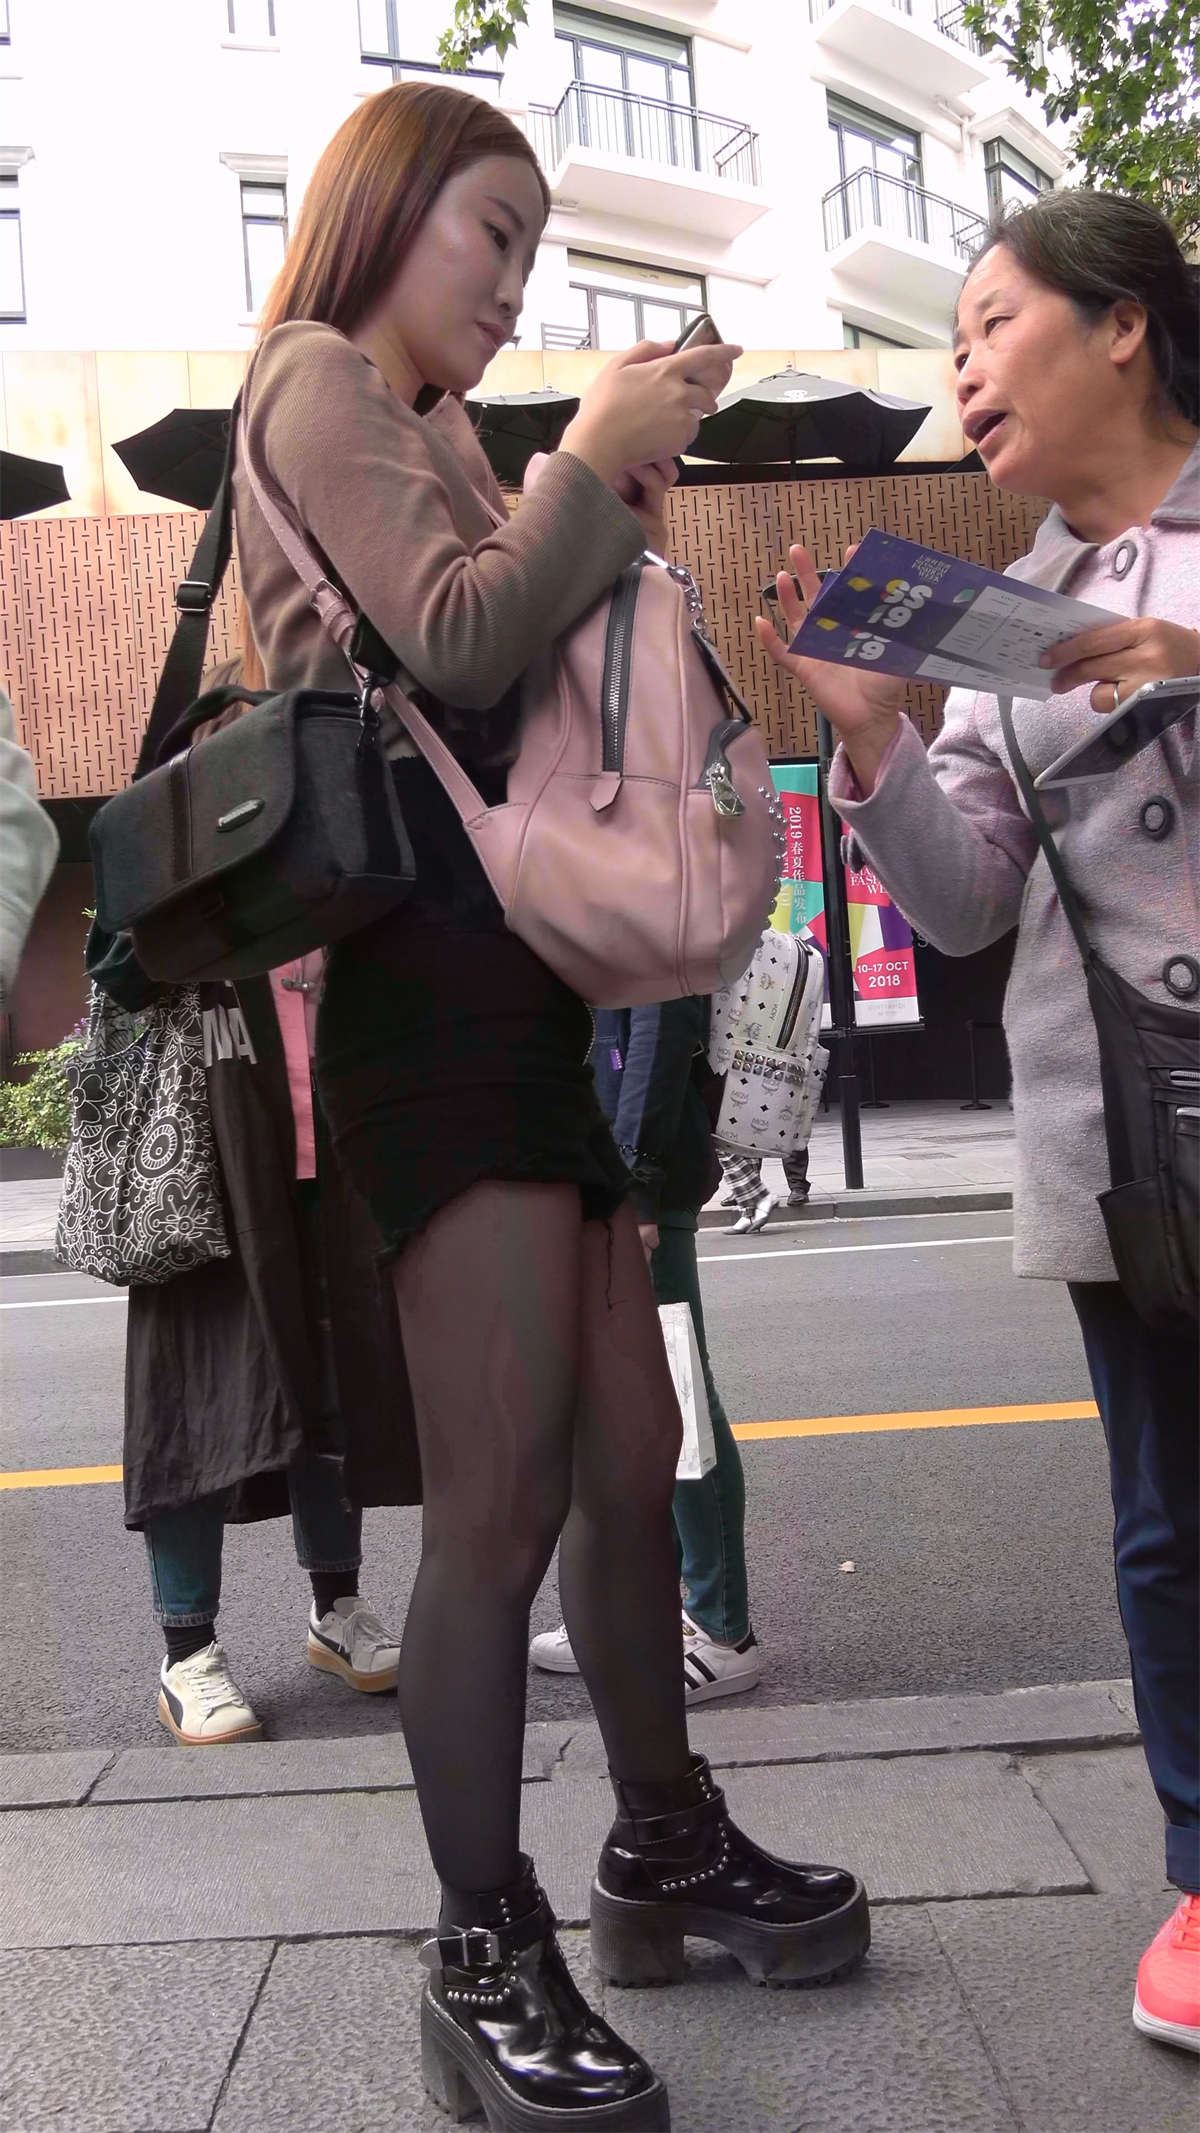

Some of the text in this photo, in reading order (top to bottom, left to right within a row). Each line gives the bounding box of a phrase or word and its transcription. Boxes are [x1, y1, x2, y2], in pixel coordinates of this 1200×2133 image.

[882, 579, 933, 610] SS
[789, 806, 804, 840] 2019
[885, 960, 909, 972] OCT
[868, 974, 901, 988] 2018
